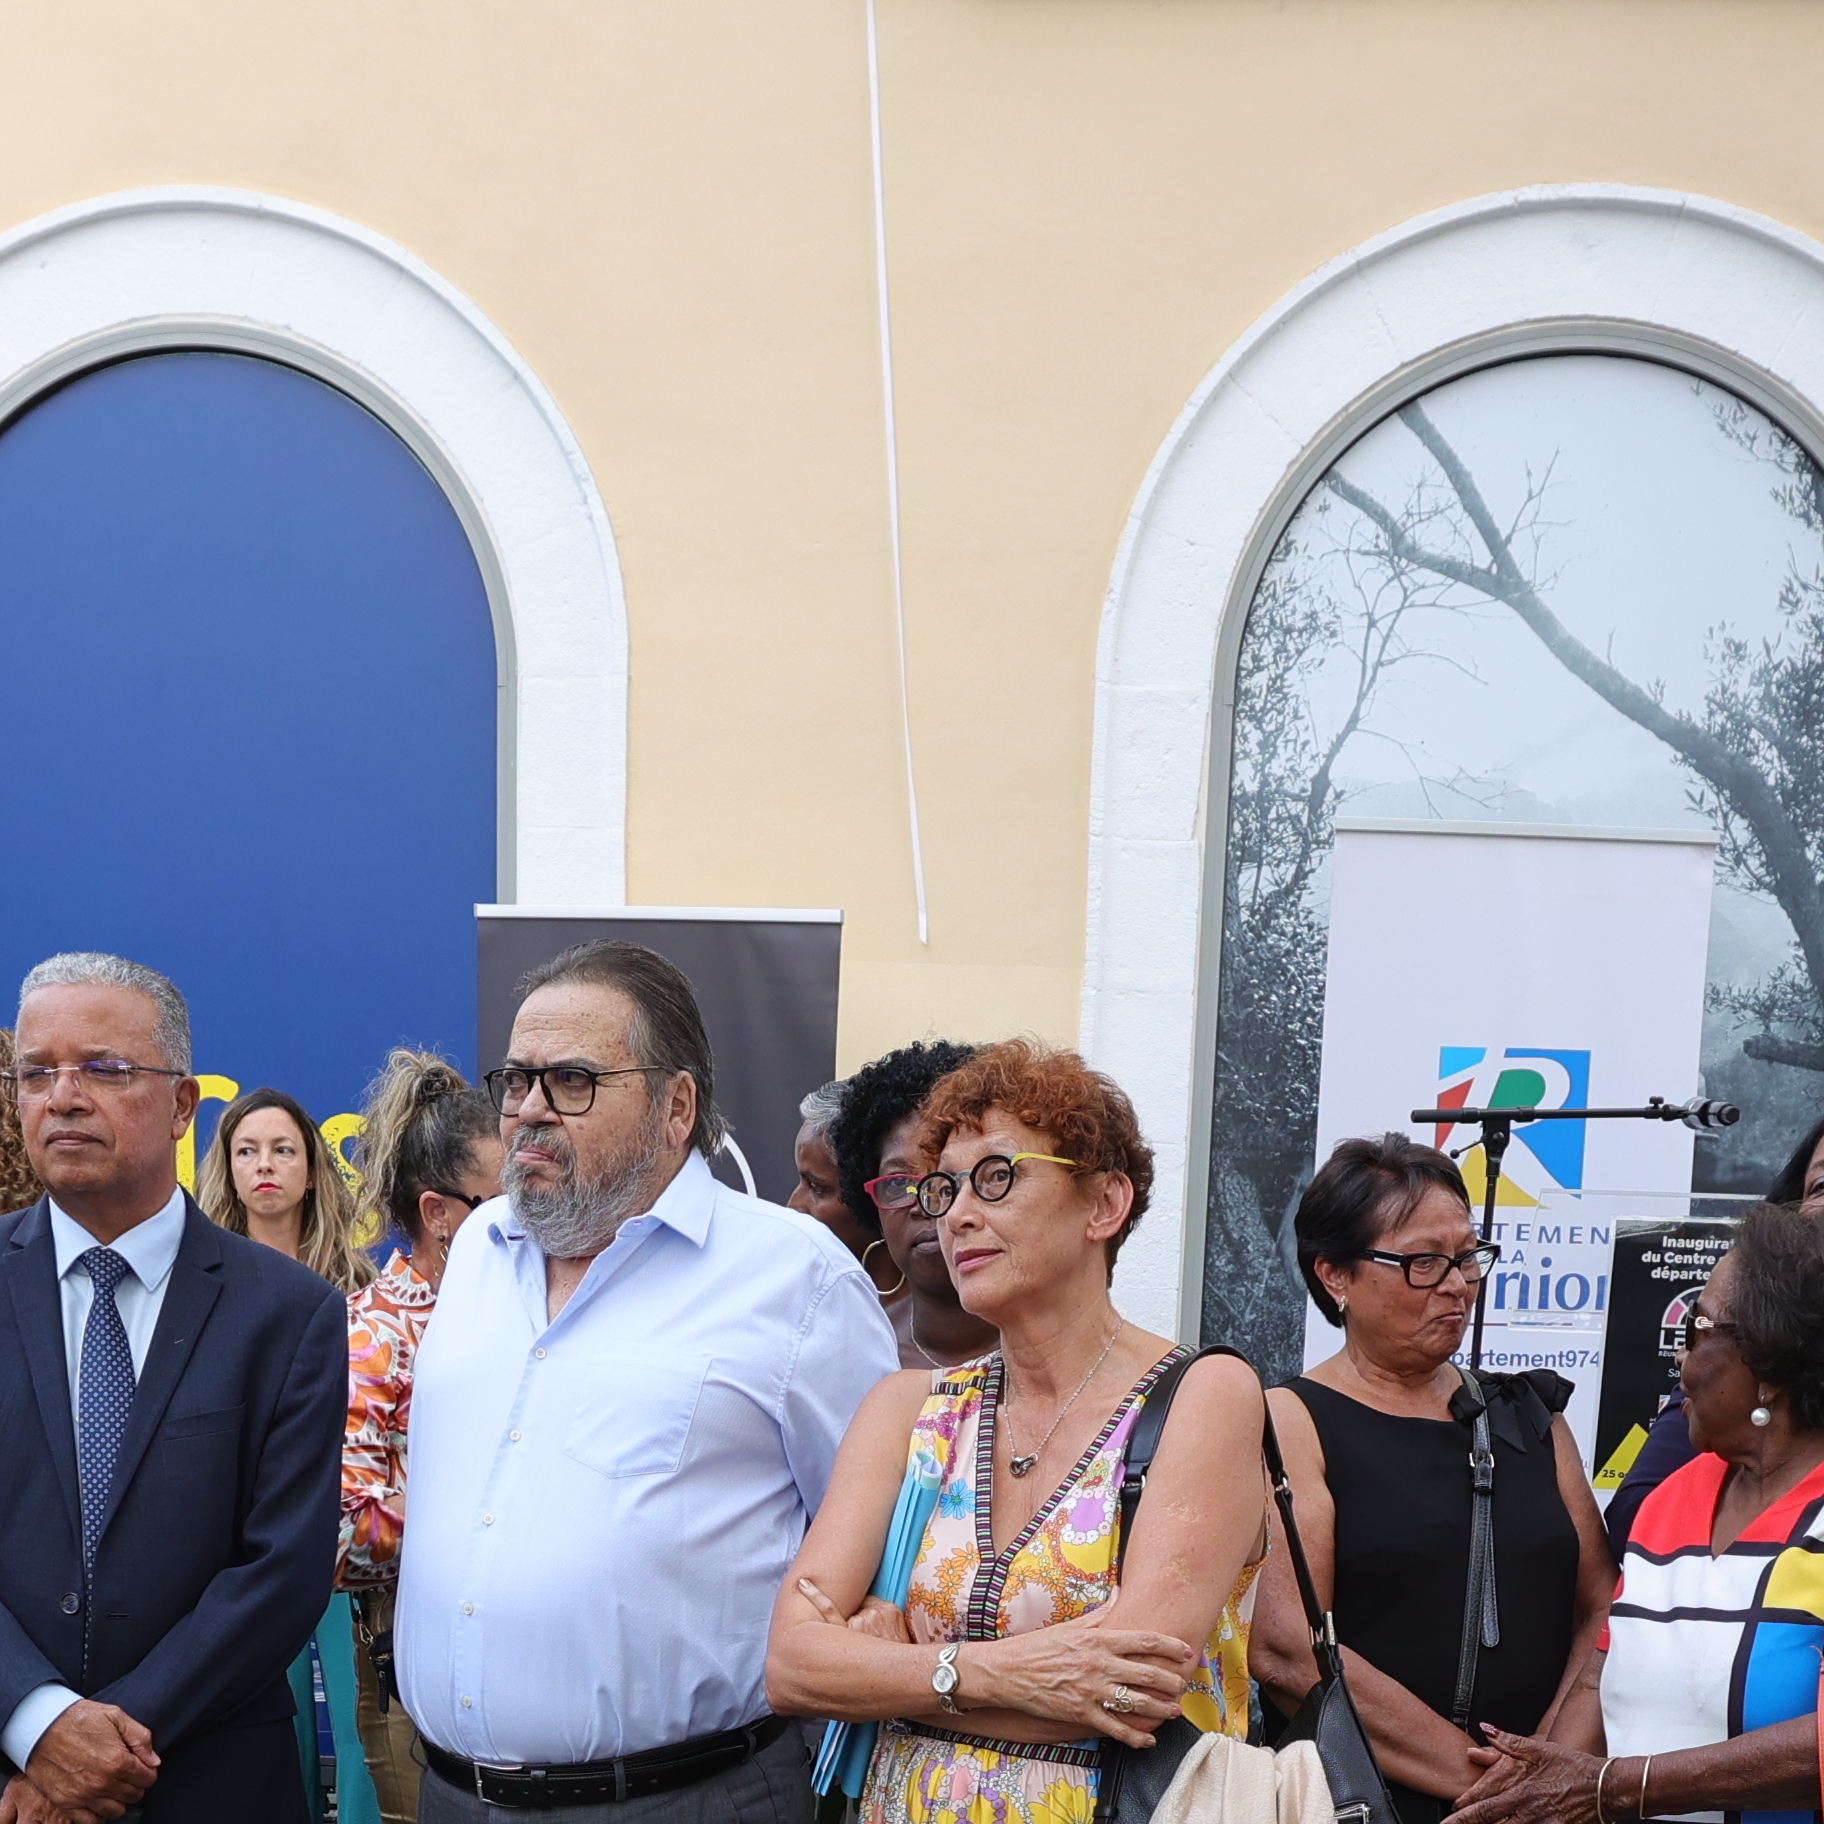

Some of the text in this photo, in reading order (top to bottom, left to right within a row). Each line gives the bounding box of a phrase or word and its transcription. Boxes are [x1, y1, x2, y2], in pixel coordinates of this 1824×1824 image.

[1641, 1250, 1716, 1265] du Centre
[1602, 1469, 1616, 1478] 25
